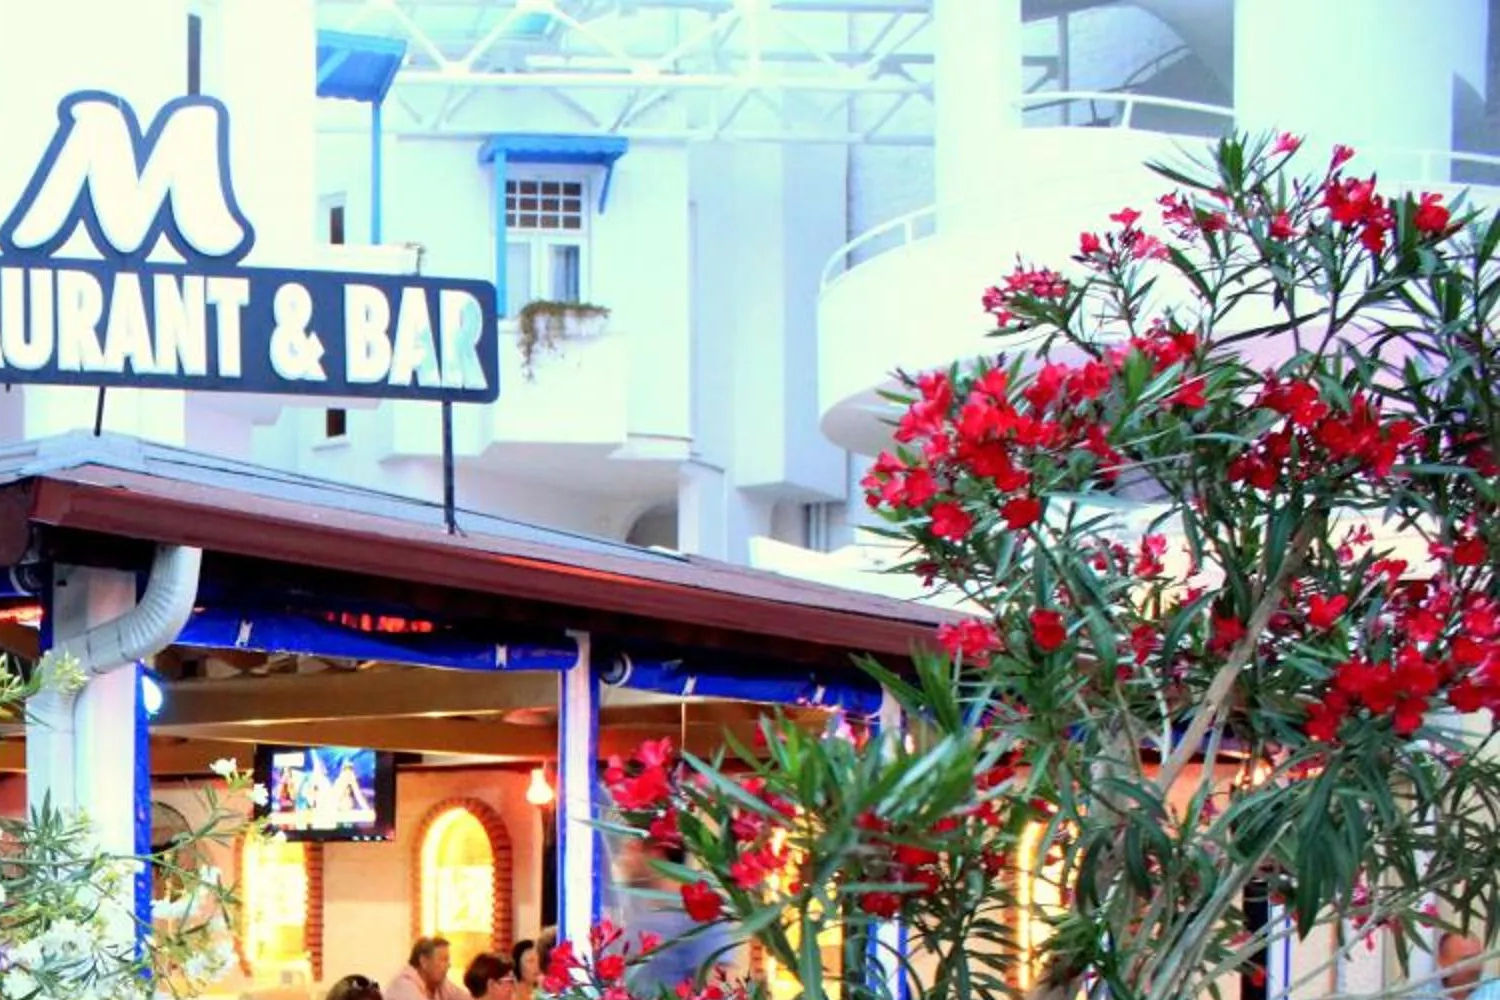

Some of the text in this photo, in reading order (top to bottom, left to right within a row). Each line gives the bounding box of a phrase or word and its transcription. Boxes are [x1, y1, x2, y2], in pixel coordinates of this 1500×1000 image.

[0, 90, 255, 263] M
[269, 281, 327, 382] &
[344, 284, 488, 390] BAR
